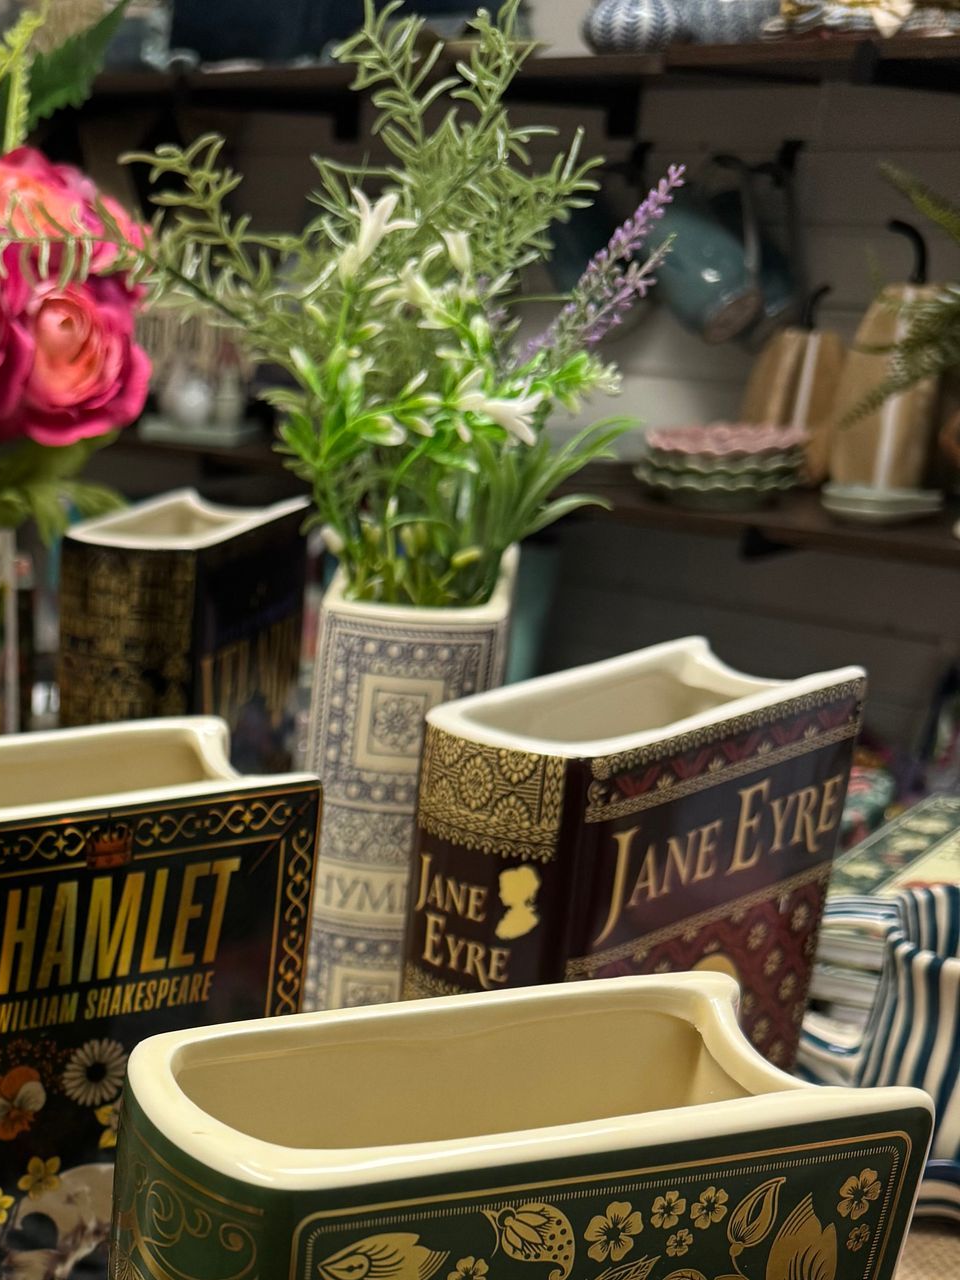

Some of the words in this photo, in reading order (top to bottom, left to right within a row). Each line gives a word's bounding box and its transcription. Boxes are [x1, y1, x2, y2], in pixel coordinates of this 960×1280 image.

[416, 853, 489, 923] JANE
[595, 821, 724, 946] JANE
[727, 776, 842, 874] EYRE
[422, 913, 511, 989] EYRE
[84, 970, 215, 1020] SHAKESPEARE
